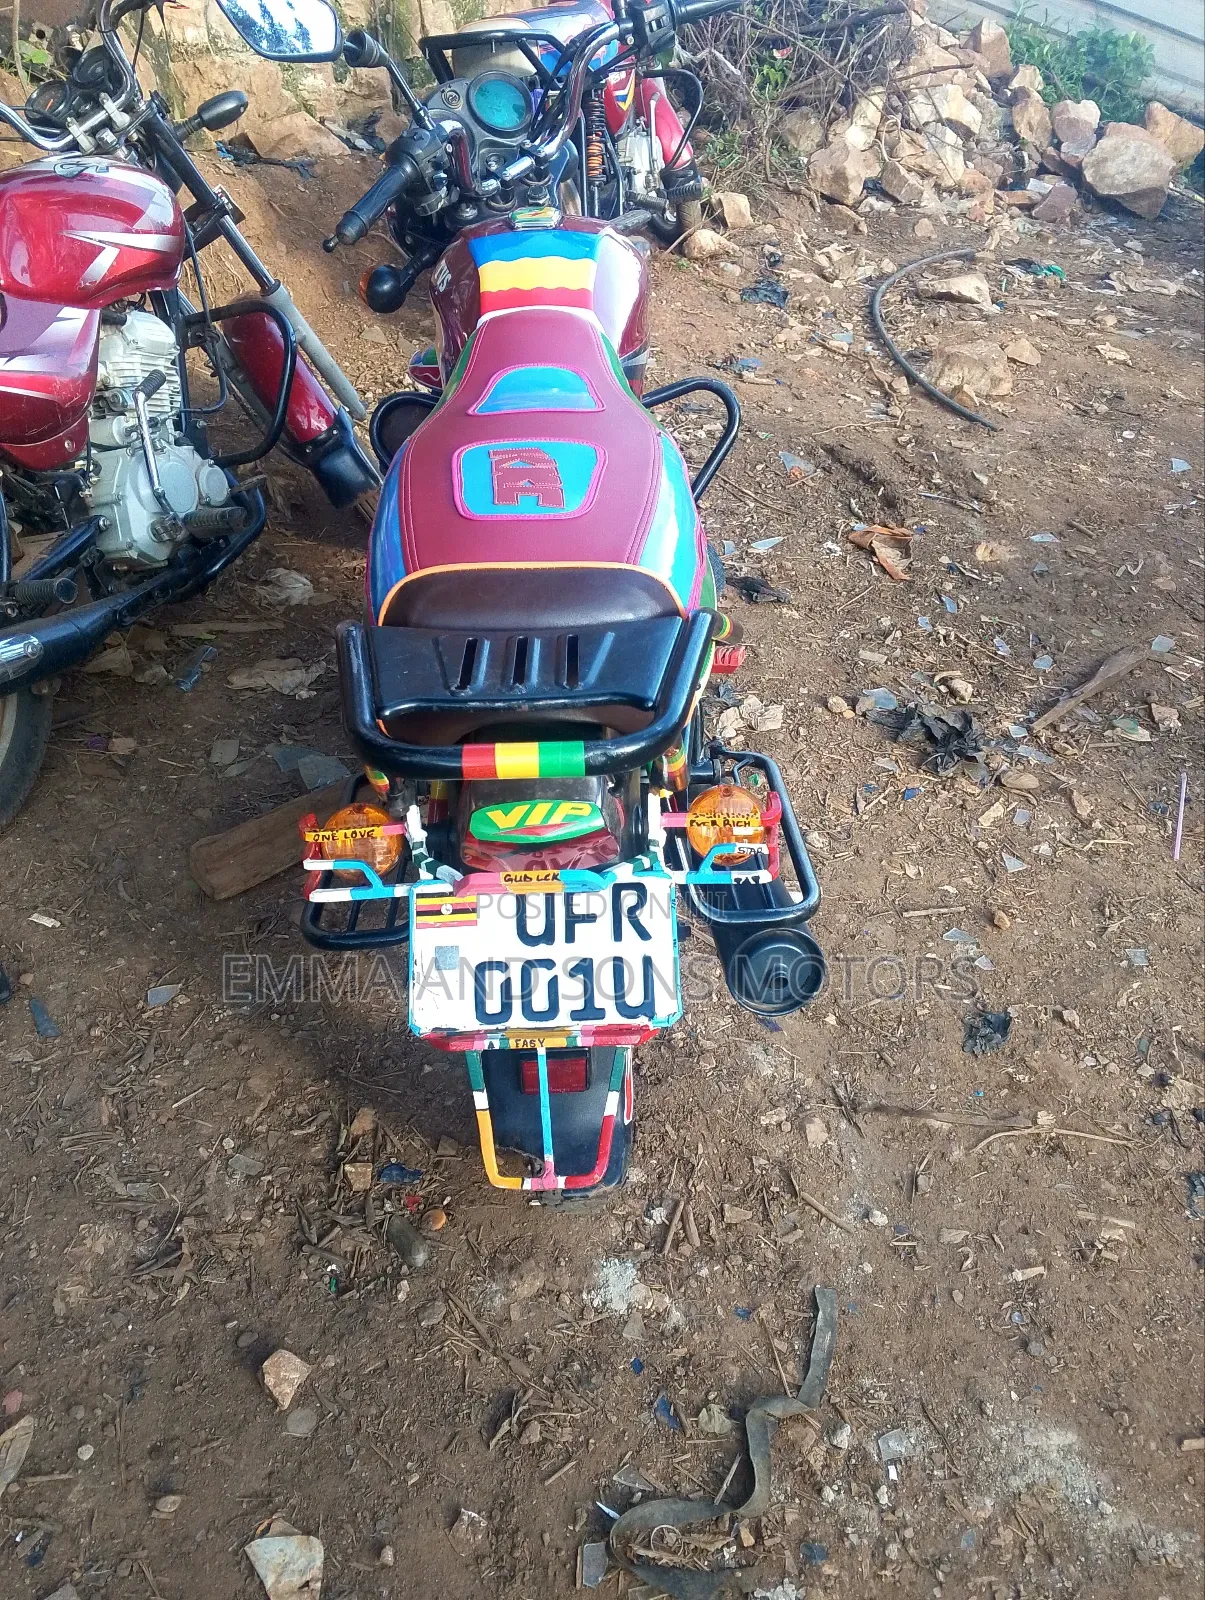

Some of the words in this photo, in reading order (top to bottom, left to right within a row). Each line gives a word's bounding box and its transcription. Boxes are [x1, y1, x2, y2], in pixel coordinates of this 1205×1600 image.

[486, 803, 592, 829] VIP
[722, 819, 751, 828] RICH
[312, 831, 340, 842] ONE
[343, 829, 376, 840] LOVE
[737, 846, 765, 855] STAR
[516, 883, 653, 947] UFR
[514, 1037, 546, 1049] EASY
